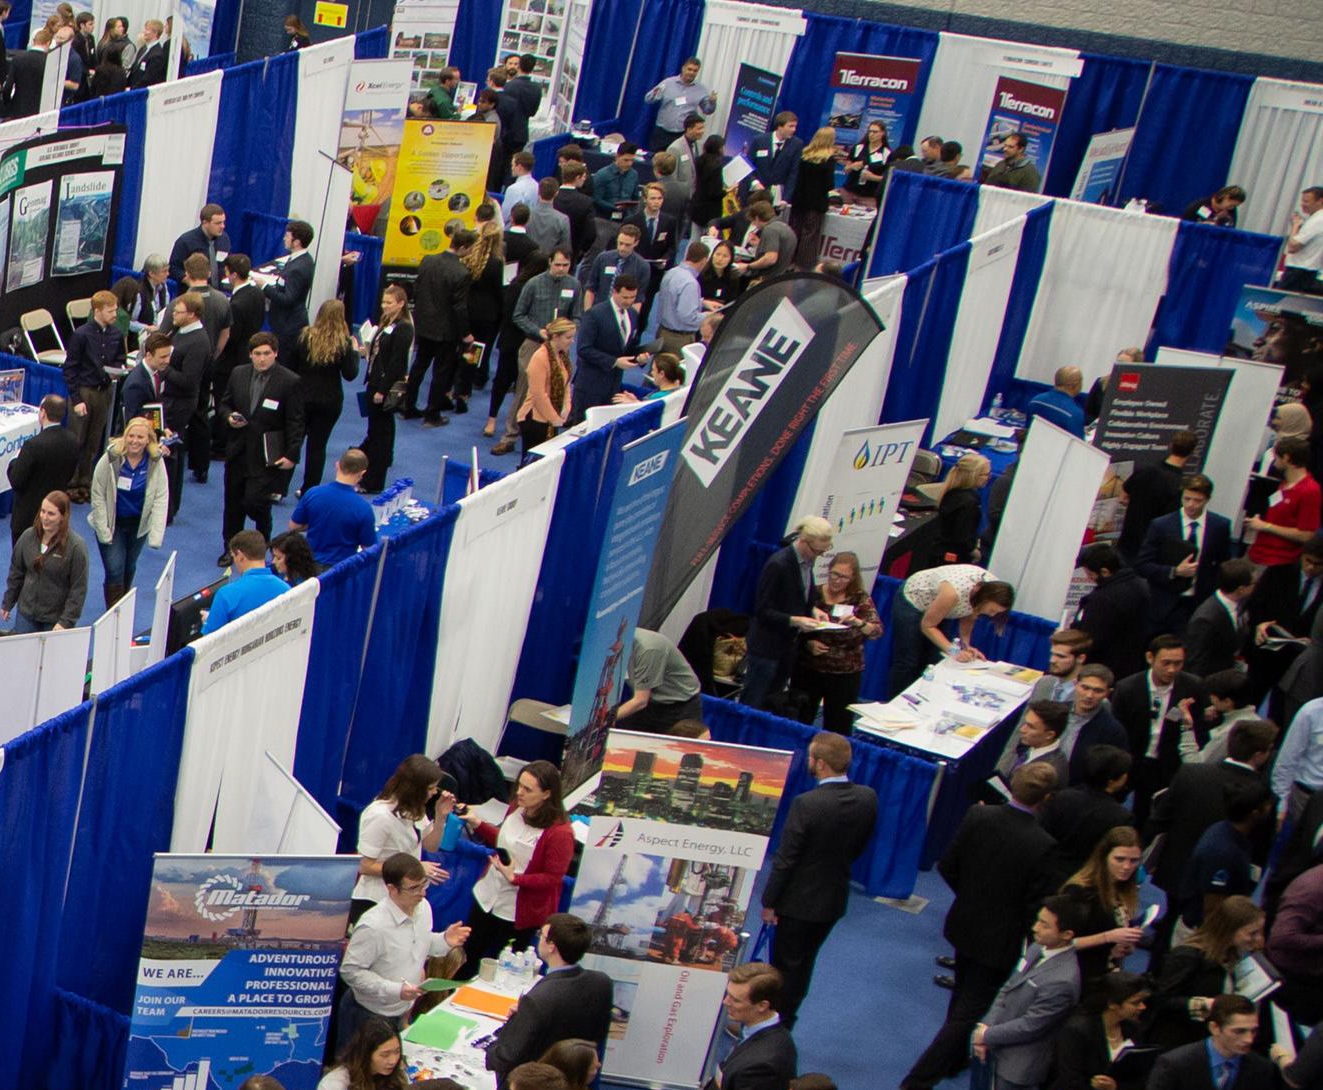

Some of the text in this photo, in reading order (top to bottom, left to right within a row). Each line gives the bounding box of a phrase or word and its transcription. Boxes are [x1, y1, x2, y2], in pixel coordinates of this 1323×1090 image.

[840, 68, 907, 90] Terracon
[1000, 91, 1055, 120] Terracon
[65, 182, 107, 201] Landslide
[689, 327, 801, 466] KEANE
[772, 341, 858, 456] DONE RIGHT THE FIRST TIME
[870, 440, 915, 468] IPT
[224, 648, 241, 665] ENERGY
[636, 832, 753, 858] Aspect Energy, LLC
[206, 889, 311, 907] Matador
[142, 966, 205, 980] WE ARE...
[137, 995, 186, 1004] JOIN OUR
[226, 993, 332, 1004] A PLACE TO GROW.
[136, 1006, 166, 1017] TEAM
[656, 970, 690, 1065] Oil and Gas Exploration
